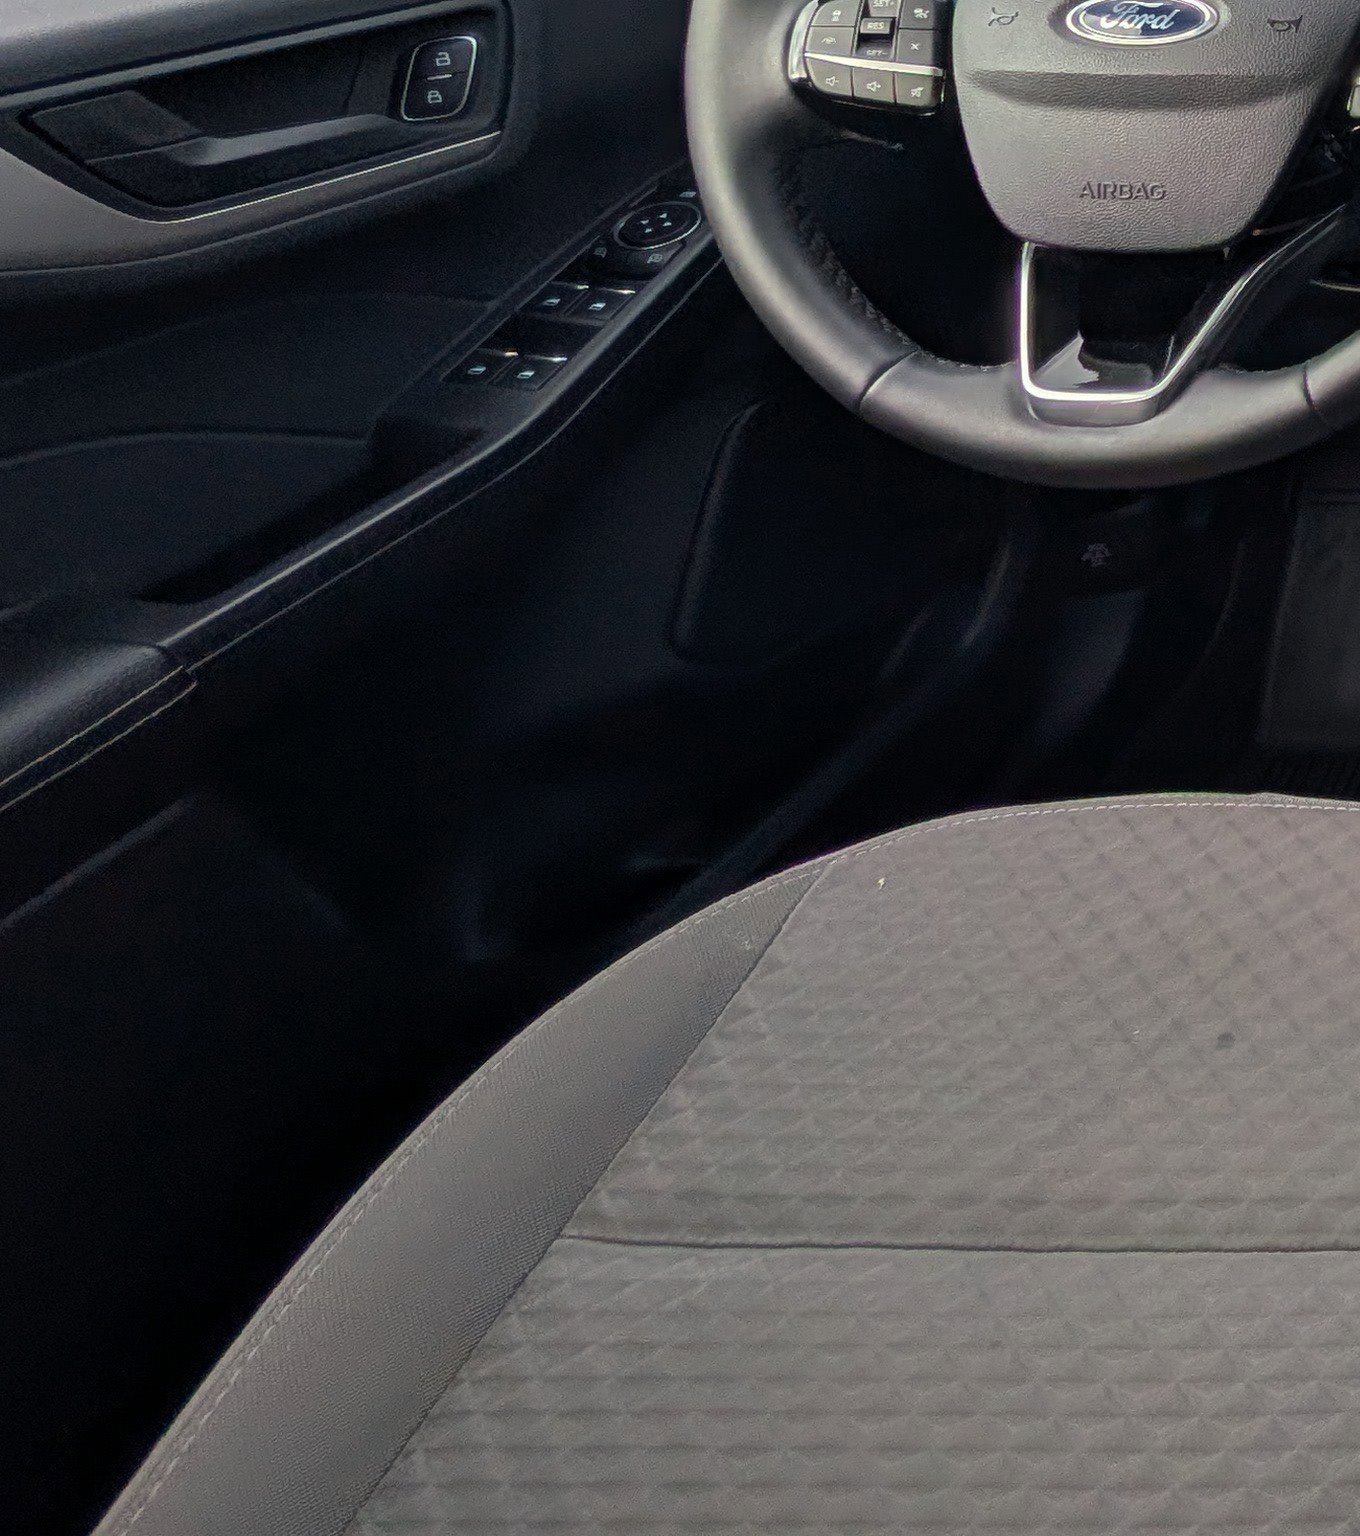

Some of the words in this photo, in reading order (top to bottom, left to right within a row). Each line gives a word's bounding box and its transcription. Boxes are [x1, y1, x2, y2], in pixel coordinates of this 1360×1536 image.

[1100, 0, 1181, 30] Ford
[867, 21, 885, 31] RES
[1079, 181, 1168, 200] AIRBAG
